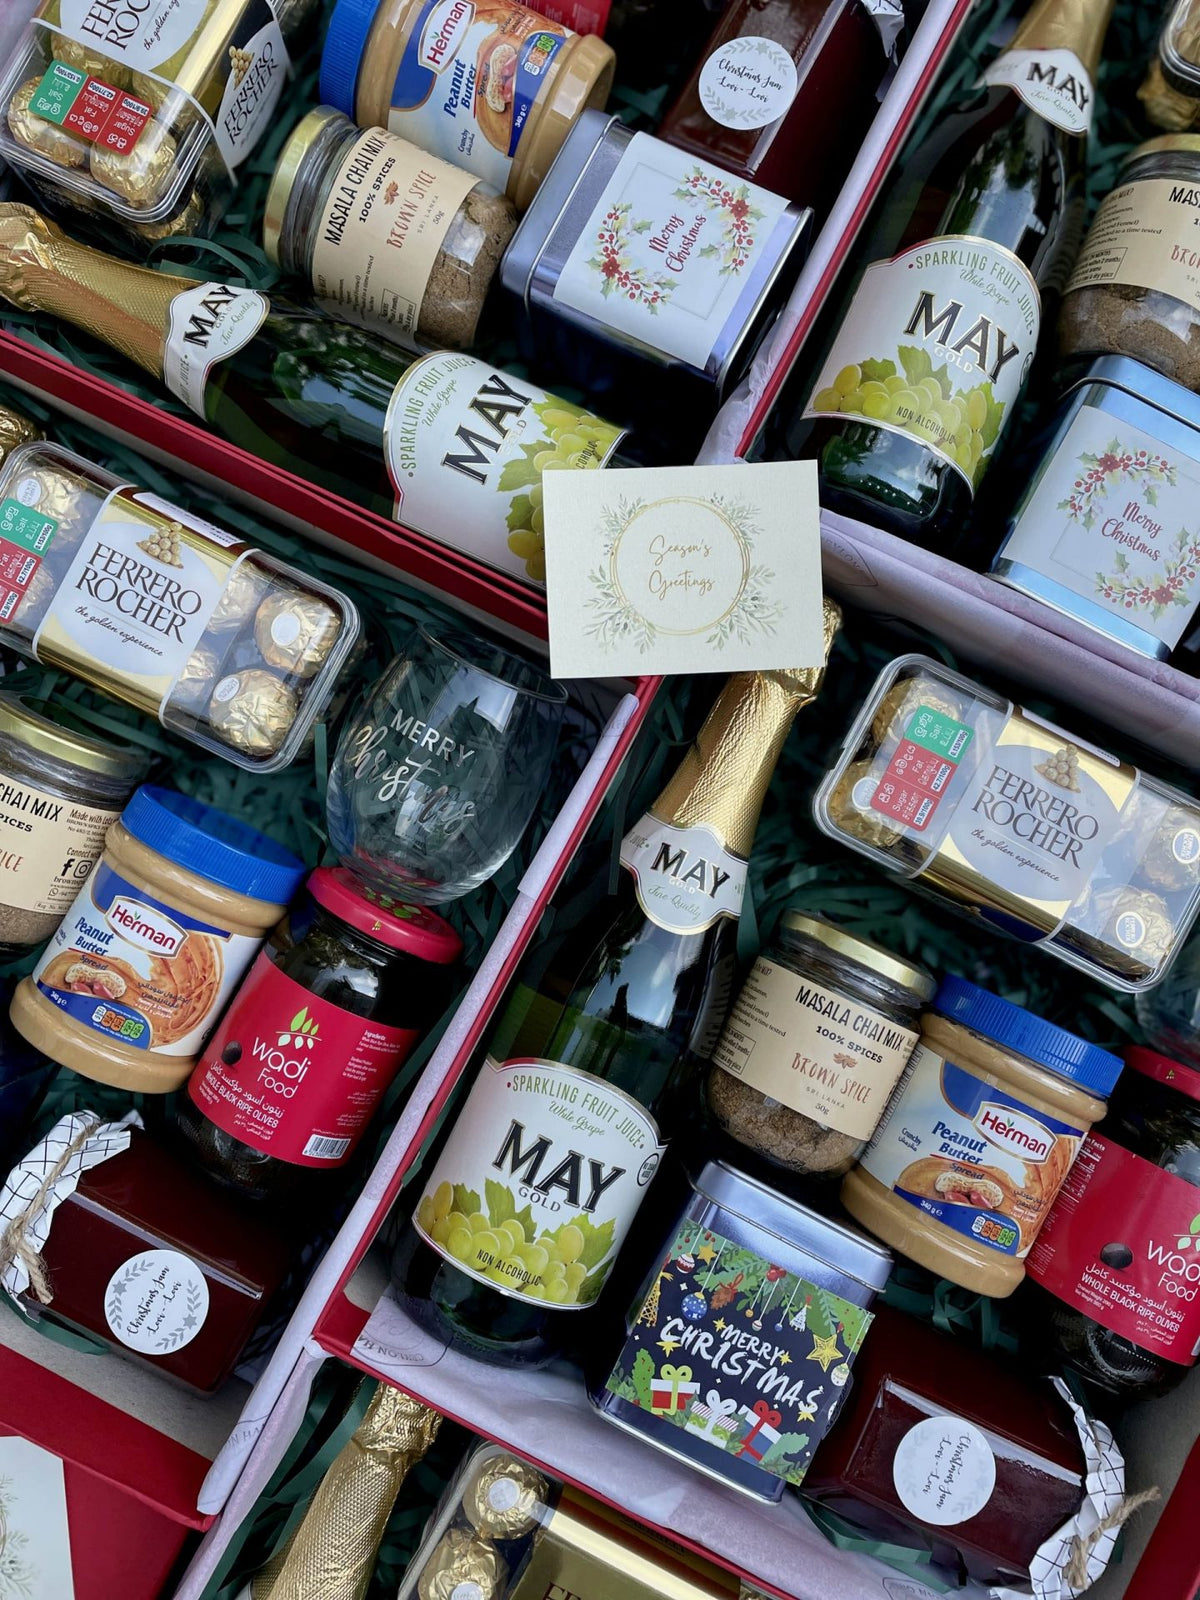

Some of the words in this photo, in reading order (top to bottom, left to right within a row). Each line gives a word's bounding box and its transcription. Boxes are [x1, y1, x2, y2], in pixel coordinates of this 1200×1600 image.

[144, 38, 155, 51] the
[153, 10, 170, 42] golden
[427, 2, 468, 65] Herman
[224, 41, 273, 133] FERRERO
[443, 59, 466, 118] Peanut
[461, 64, 477, 110] Butter
[716, 58, 761, 84] Christmas
[762, 75, 784, 91] Jam
[1026, 62, 1090, 112] MAY
[48, 88, 64, 101] Salt
[84, 106, 97, 118] Fat
[228, 58, 280, 145] ROCHER
[114, 121, 136, 137] Sugar
[515, 114, 523, 127] 340
[458, 129, 470, 152] Crunchy
[324, 186, 358, 246] MASALA
[345, 153, 374, 186] CHAI
[361, 136, 387, 160] MIX
[359, 194, 377, 223] 100%
[372, 157, 396, 191] SPICES
[386, 199, 420, 249] BROWN
[408, 169, 437, 199] SPICE
[649, 212, 685, 254] Merry
[665, 214, 708, 274] Christmas
[916, 250, 987, 271] SPARKLING
[990, 262, 1021, 294] FRUIT
[1017, 293, 1036, 331] JUICE
[960, 268, 985, 289] White
[984, 282, 1012, 307] Grape
[183, 285, 241, 349] MAY
[231, 299, 257, 328] Quality
[904, 289, 1020, 385] MAY
[934, 346, 973, 374] GOLD
[401, 398, 424, 470] SPARKLING
[415, 367, 444, 397] FRUIT
[446, 357, 471, 373] JUICE
[422, 400, 442, 428] White
[437, 379, 458, 407] Grape
[440, 374, 532, 486] MAY
[896, 406, 914, 421] NON
[915, 413, 957, 445] ALCOHOLIC
[16, 517, 28, 533] Salt
[1101, 518, 1160, 561] Christmas
[1123, 501, 1163, 539] Merry
[649, 535, 713, 566] Season's
[88, 542, 202, 615] FERRERO
[648, 569, 716, 600] Greetings
[75, 566, 187, 643] ROCHER
[75, 606, 90, 618] the
[89, 615, 119, 637] golden
[118, 629, 164, 657] experience
[391, 709, 475, 767] MERRY
[929, 723, 943, 740] Salt
[912, 760, 924, 773] Fat
[932, 764, 951, 791] 42.7/100g
[30, 798, 63, 822] MIX
[70, 809, 88, 821] Made
[89, 814, 101, 824] with
[892, 789, 908, 812] Sugar
[984, 765, 1099, 841] FERRERO
[972, 789, 1083, 870] ROCHER
[67, 847, 90, 858] Connect
[651, 842, 730, 898] MAY
[970, 828, 985, 841] the
[984, 836, 1014, 858] golden
[1014, 856, 1060, 882] experience
[649, 884, 669, 900] Fine
[671, 894, 703, 920] Quality
[74, 916, 114, 946] Peanut
[75, 937, 107, 956] Butter
[112, 904, 176, 950] Herman
[80, 954, 108, 971] Spread
[769, 1025, 787, 1038] tested
[795, 986, 852, 1027] MASALA
[852, 1015, 884, 1042] CHAI
[882, 1028, 906, 1052] MIX
[816, 1025, 845, 1045] 100%
[847, 1041, 884, 1064] SPICES
[257, 1068, 299, 1099] Food
[791, 1052, 840, 1089] BROWN
[840, 1078, 873, 1104] SPICE
[205, 1071, 221, 1092] WHOLE
[218, 1085, 238, 1105] BLACK
[238, 1099, 253, 1115] RIPE
[252, 1109, 279, 1129] OLIVES
[512, 1075, 579, 1104] SPARKLING
[582, 1093, 619, 1123] FRUIT
[616, 1117, 645, 1148] JUICE
[548, 1101, 574, 1122] White
[573, 1116, 605, 1138] Grape
[815, 1103, 830, 1115] 50g
[821, 1094, 846, 1109] LANKA
[901, 1127, 923, 1146] Crunchy
[932, 1121, 988, 1155] Peanut
[982, 1111, 1047, 1156] Herman
[492, 1119, 626, 1214] MAY
[938, 1142, 983, 1166] Butter
[950, 1162, 985, 1181] Spread
[518, 1185, 561, 1212] GOLD
[920, 1201, 932, 1213] 340
[476, 1248, 494, 1266] NON
[495, 1259, 542, 1287] ALCOHOLIC
[1085, 1263, 1109, 1280] كامل
[1158, 1272, 1198, 1302] Food
[127, 1289, 160, 1336] Christmas
[152, 1266, 170, 1289] Jam
[1081, 1272, 1110, 1295] WHOLE
[1110, 1290, 1138, 1312] BLACK
[1136, 1306, 1156, 1322] RIPE
[1155, 1315, 1180, 1333] OLIVES
[1109, 1276, 1141, 1299] مؤكسد
[1143, 1292, 1167, 1311] أسود
[1165, 1304, 1185, 1322] زيتون
[720, 1324, 784, 1362] MERRY
[660, 1316, 825, 1413] CHRISTMAS
[944, 1433, 972, 1485] Christmas
[936, 1485, 953, 1510] Jam
